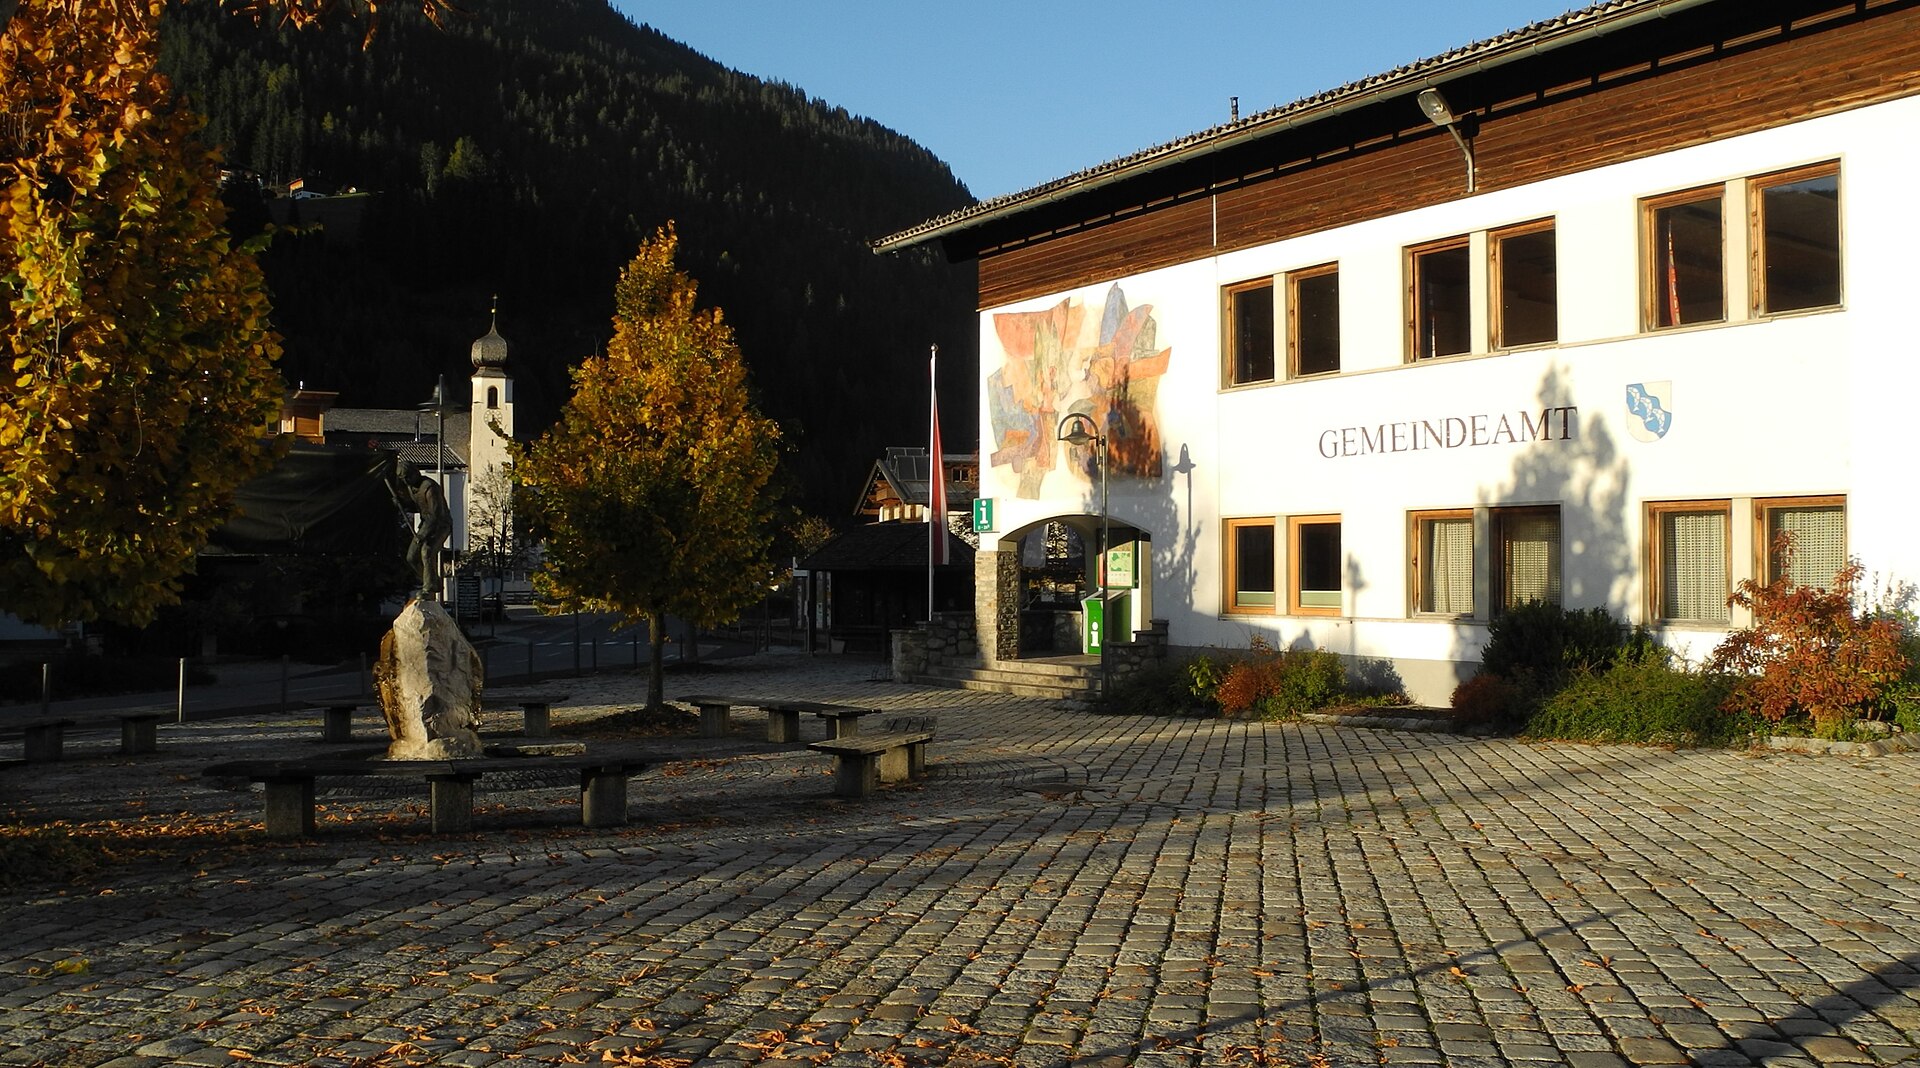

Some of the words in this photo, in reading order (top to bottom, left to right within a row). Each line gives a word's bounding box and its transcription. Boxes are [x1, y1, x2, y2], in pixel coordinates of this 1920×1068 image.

[1318, 405, 1578, 459] GEMEINDEAMT
[980, 500, 989, 525] i
[1090, 621, 1100, 647] i
